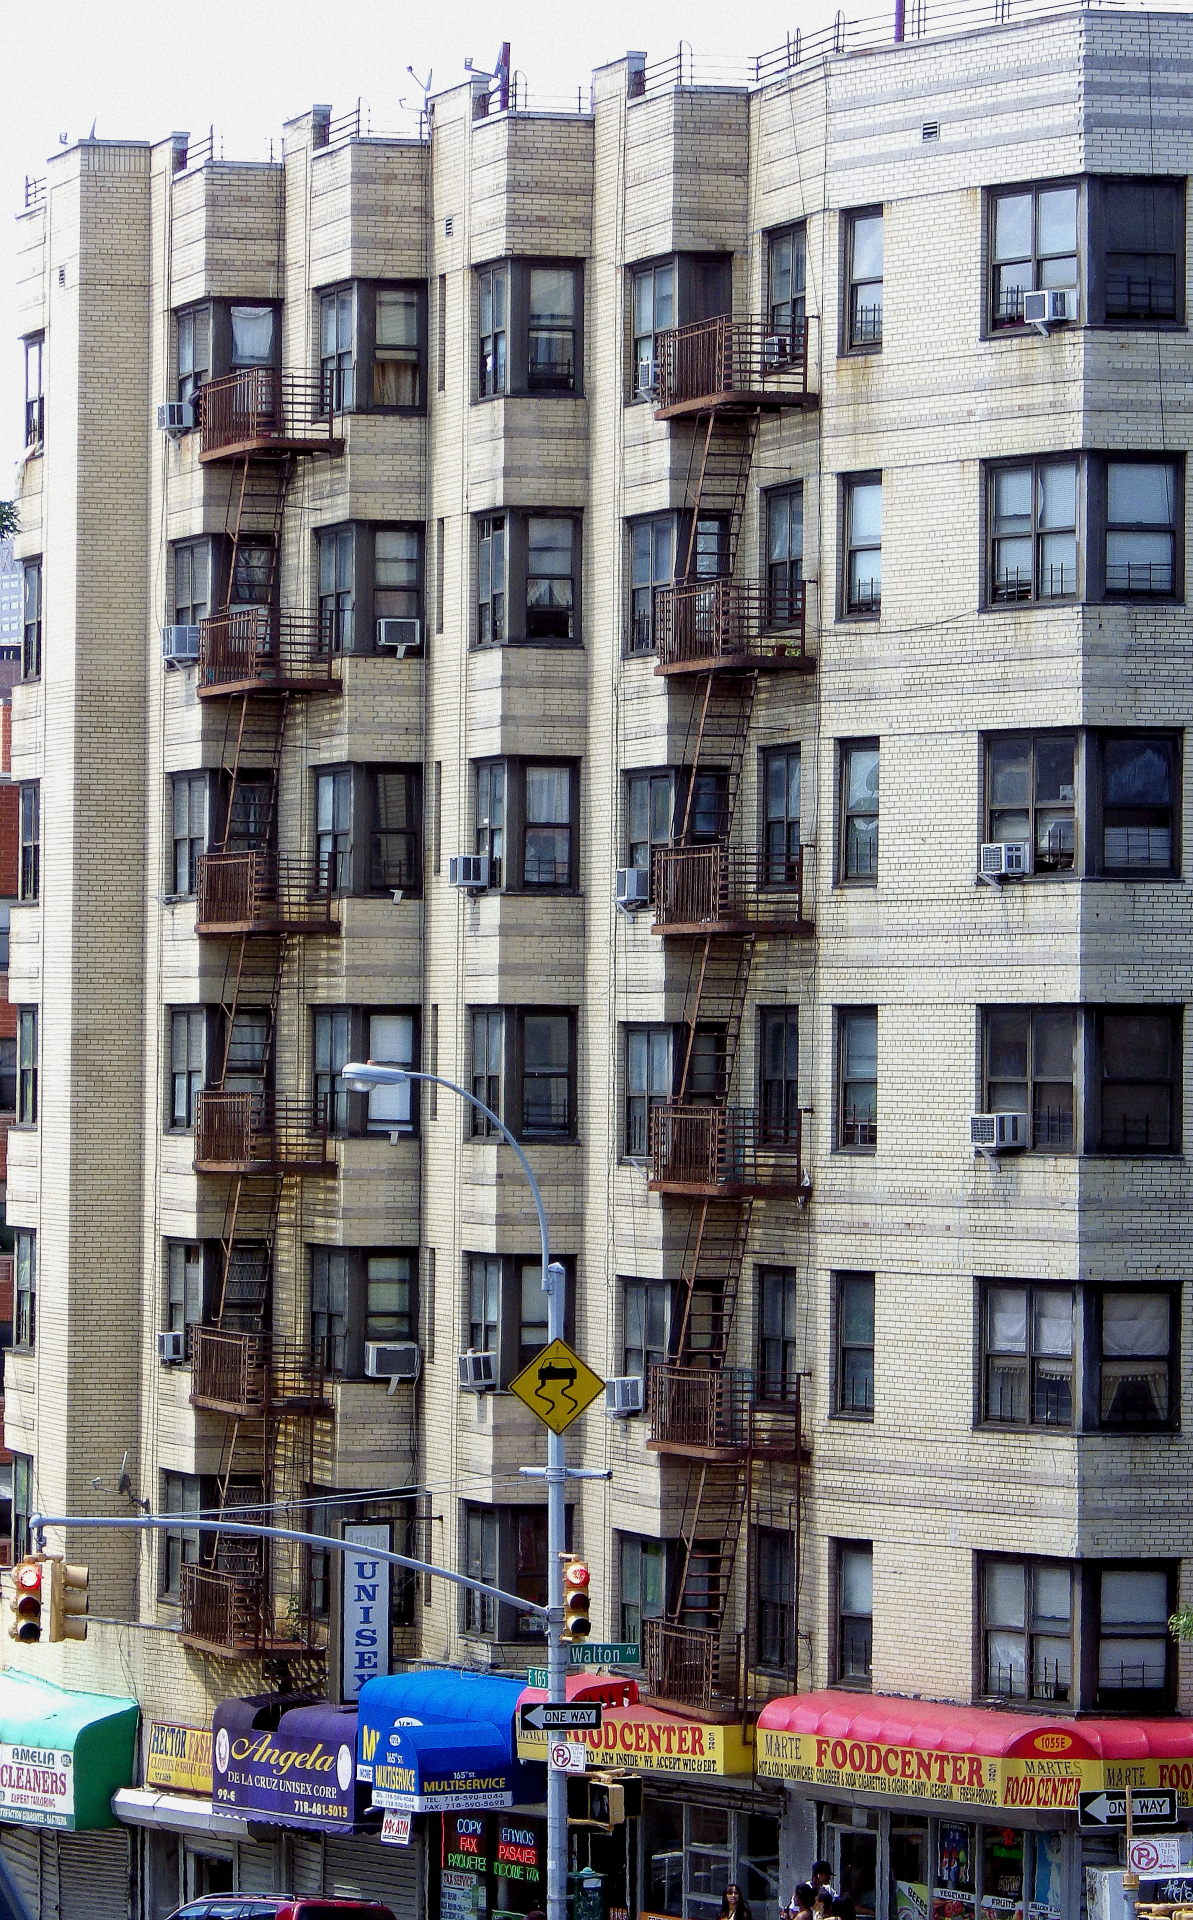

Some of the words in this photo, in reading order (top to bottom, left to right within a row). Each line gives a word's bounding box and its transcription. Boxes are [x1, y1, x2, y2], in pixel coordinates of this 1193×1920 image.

[353, 1561, 380, 1692] UNISEX
[571, 1647, 620, 1663] Walton
[626, 1647, 636, 1656] Av
[528, 1670, 533, 1685] E
[534, 1671, 546, 1687] 165
[544, 1711, 567, 1723] ONE
[570, 1711, 593, 1722] WAY
[151, 1725, 187, 1759] HECTOR
[12, 1747, 55, 1766] AMELIA
[231, 1733, 337, 1776] Angela
[601, 1751, 614, 1765] ATM
[616, 1753, 640, 1767] INSIDE
[643, 1755, 654, 1768] WE
[656, 1757, 682, 1770] ACCEPT
[765, 1733, 802, 1760] MARTE
[816, 1738, 985, 1789] FOODCENTER
[0, 1763, 67, 1797] CLEANERS
[227, 1770, 240, 1784] DE
[241, 1773, 253, 1786] LA
[254, 1775, 279, 1791] CRUZ
[279, 1779, 313, 1797] UNISEX
[375, 1765, 415, 1792] MULTISERVICE
[423, 1777, 506, 1793] MULTISERVICE
[1106, 1767, 1146, 1787] MARTE
[11, 1793, 31, 1807] EXPERT
[31, 1795, 56, 1809] TAILORING
[444, 1792, 504, 1802] 718-590-8044
[1004, 1776, 1037, 1806] FOOD
[1037, 1777, 1082, 1807] CENTER
[1140, 1799, 1166, 1813] WAY
[396, 1820, 409, 1836] ATM
[457, 1818, 482, 1835] COPY
[460, 1837, 478, 1853] FAX
[502, 1827, 535, 1846] ENVIOS
[499, 1845, 537, 1865] PASAJES
[526, 1867, 540, 1883] TAX
[907, 1886, 928, 1916] BEERS
[939, 1889, 972, 1902] VEGETABLE
[991, 1898, 1016, 1909] FRUITS
